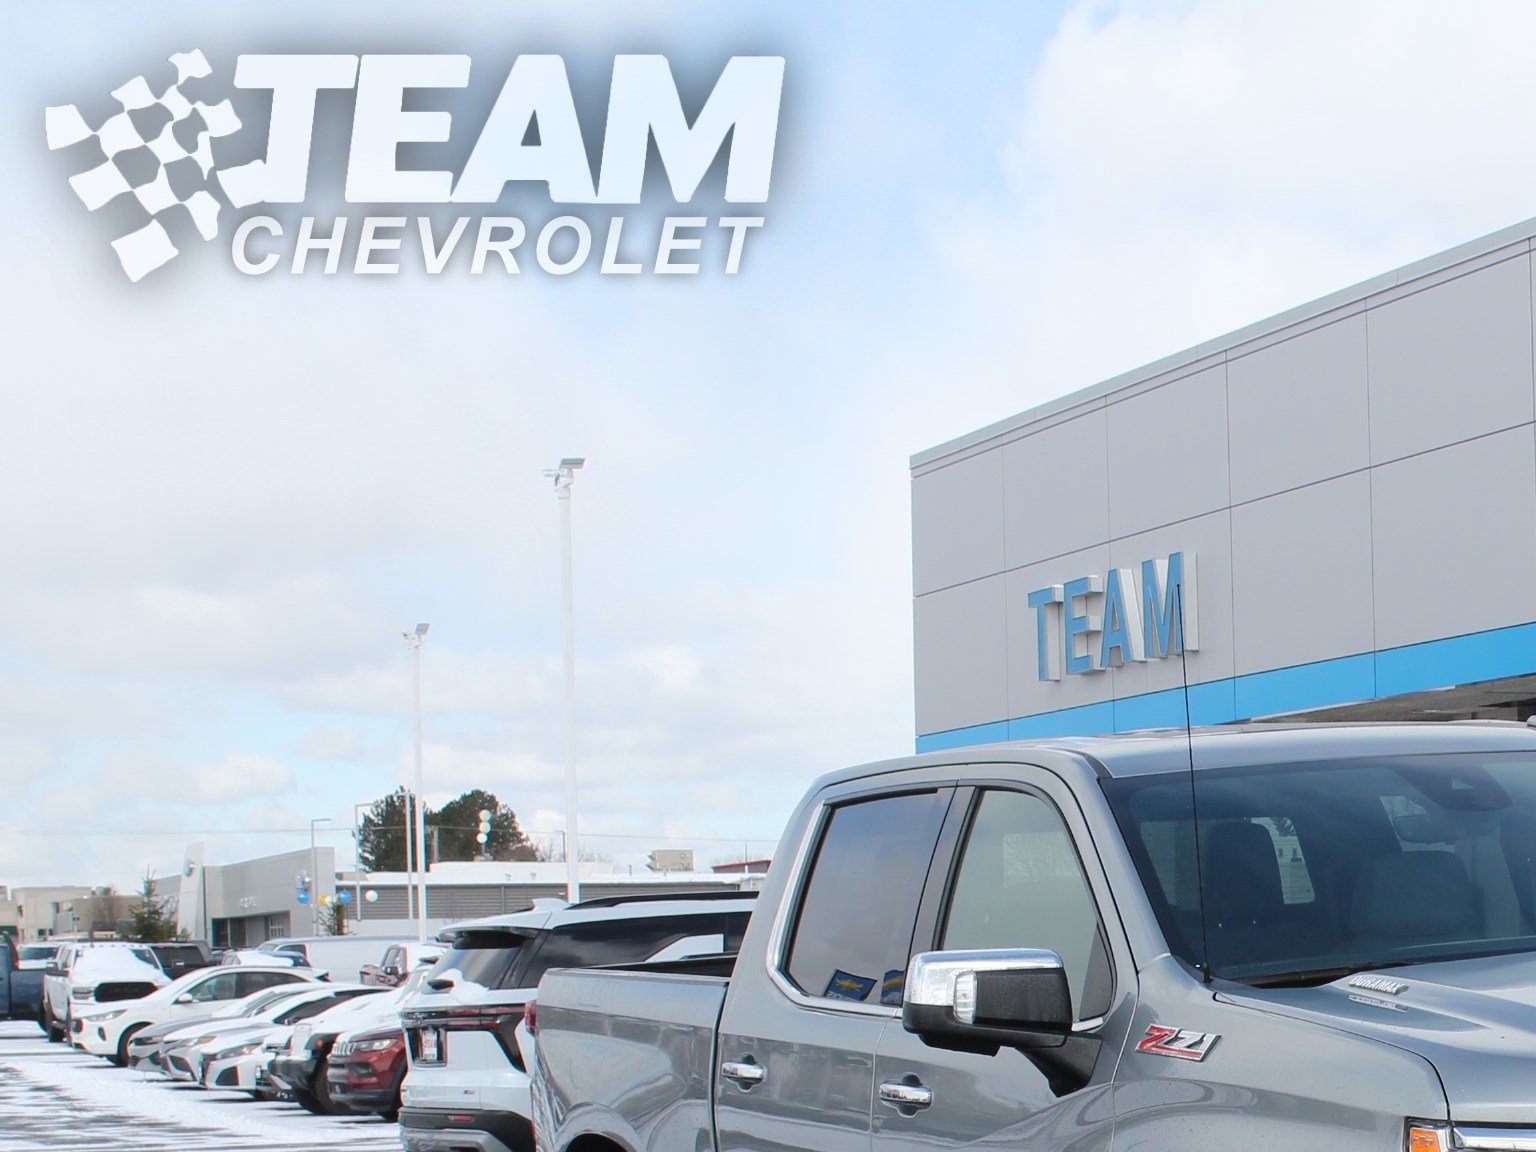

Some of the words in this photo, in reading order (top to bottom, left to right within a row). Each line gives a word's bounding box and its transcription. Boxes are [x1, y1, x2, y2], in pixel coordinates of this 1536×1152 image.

[1028, 551, 1199, 682] TEAM
[1348, 975, 1407, 995] DURAMAX
[1135, 1023, 1220, 1062] Z71
